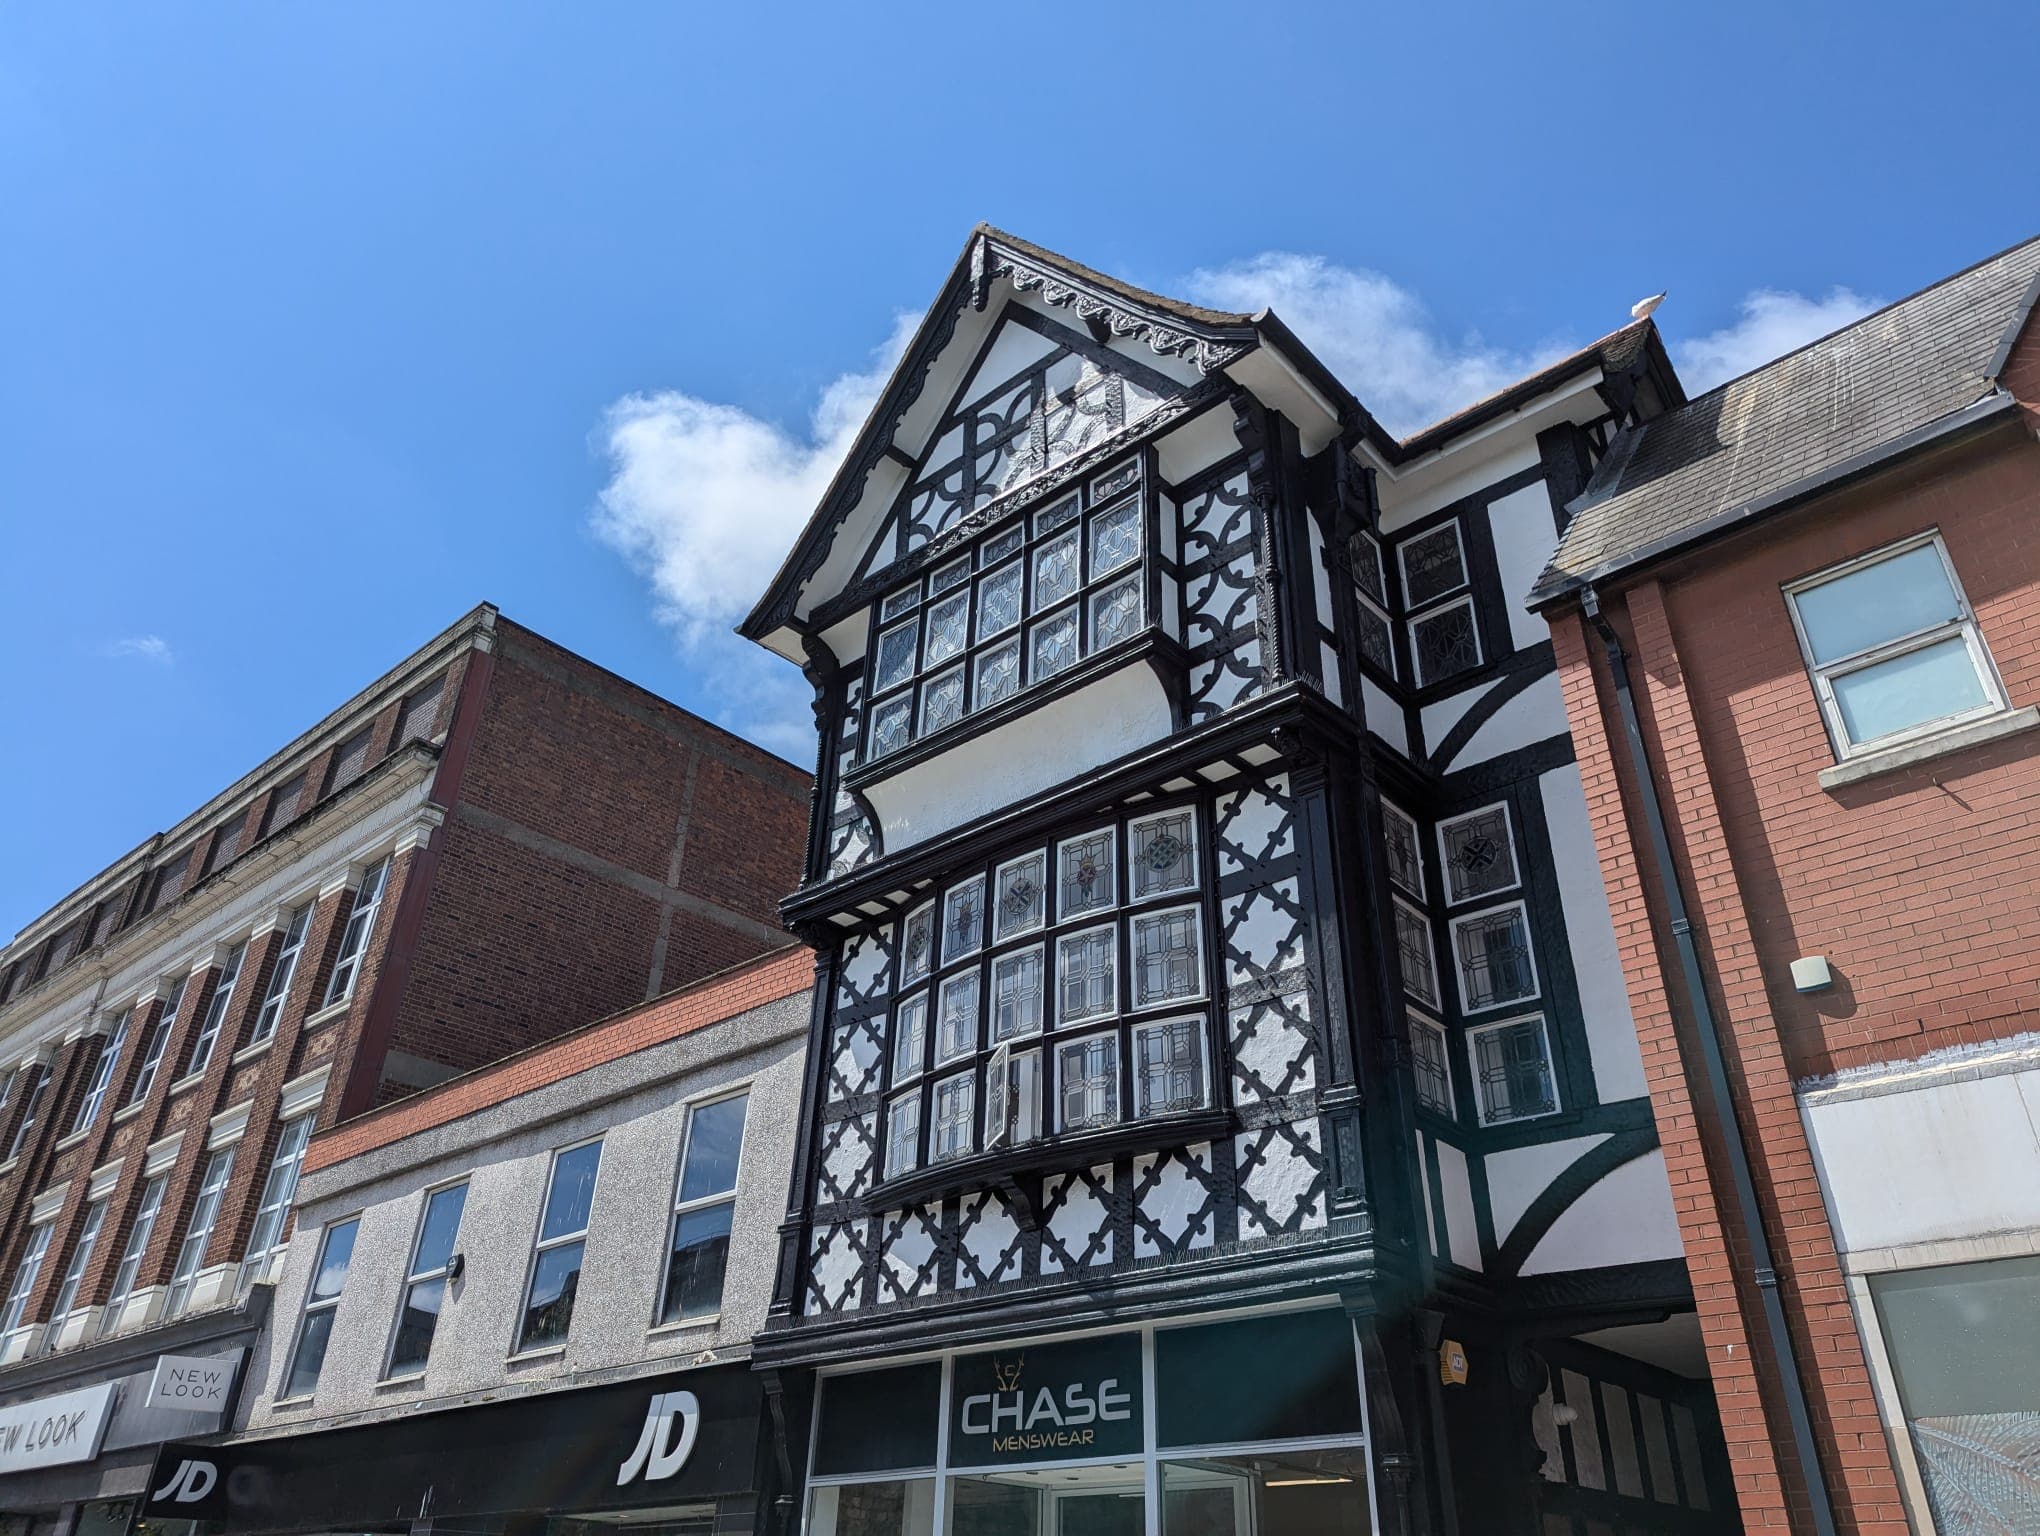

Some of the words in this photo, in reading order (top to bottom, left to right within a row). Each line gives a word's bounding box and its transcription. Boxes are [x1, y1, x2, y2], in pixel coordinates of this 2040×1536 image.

[161, 1383, 222, 1399] LOOK
[169, 1368, 222, 1384] NEW
[961, 1378, 1131, 1435] CHASE
[25, 1410, 86, 1451] LOOK
[616, 1390, 700, 1486] JD
[993, 1429, 1094, 1452] MENSWEAR
[152, 1460, 218, 1502] JD
